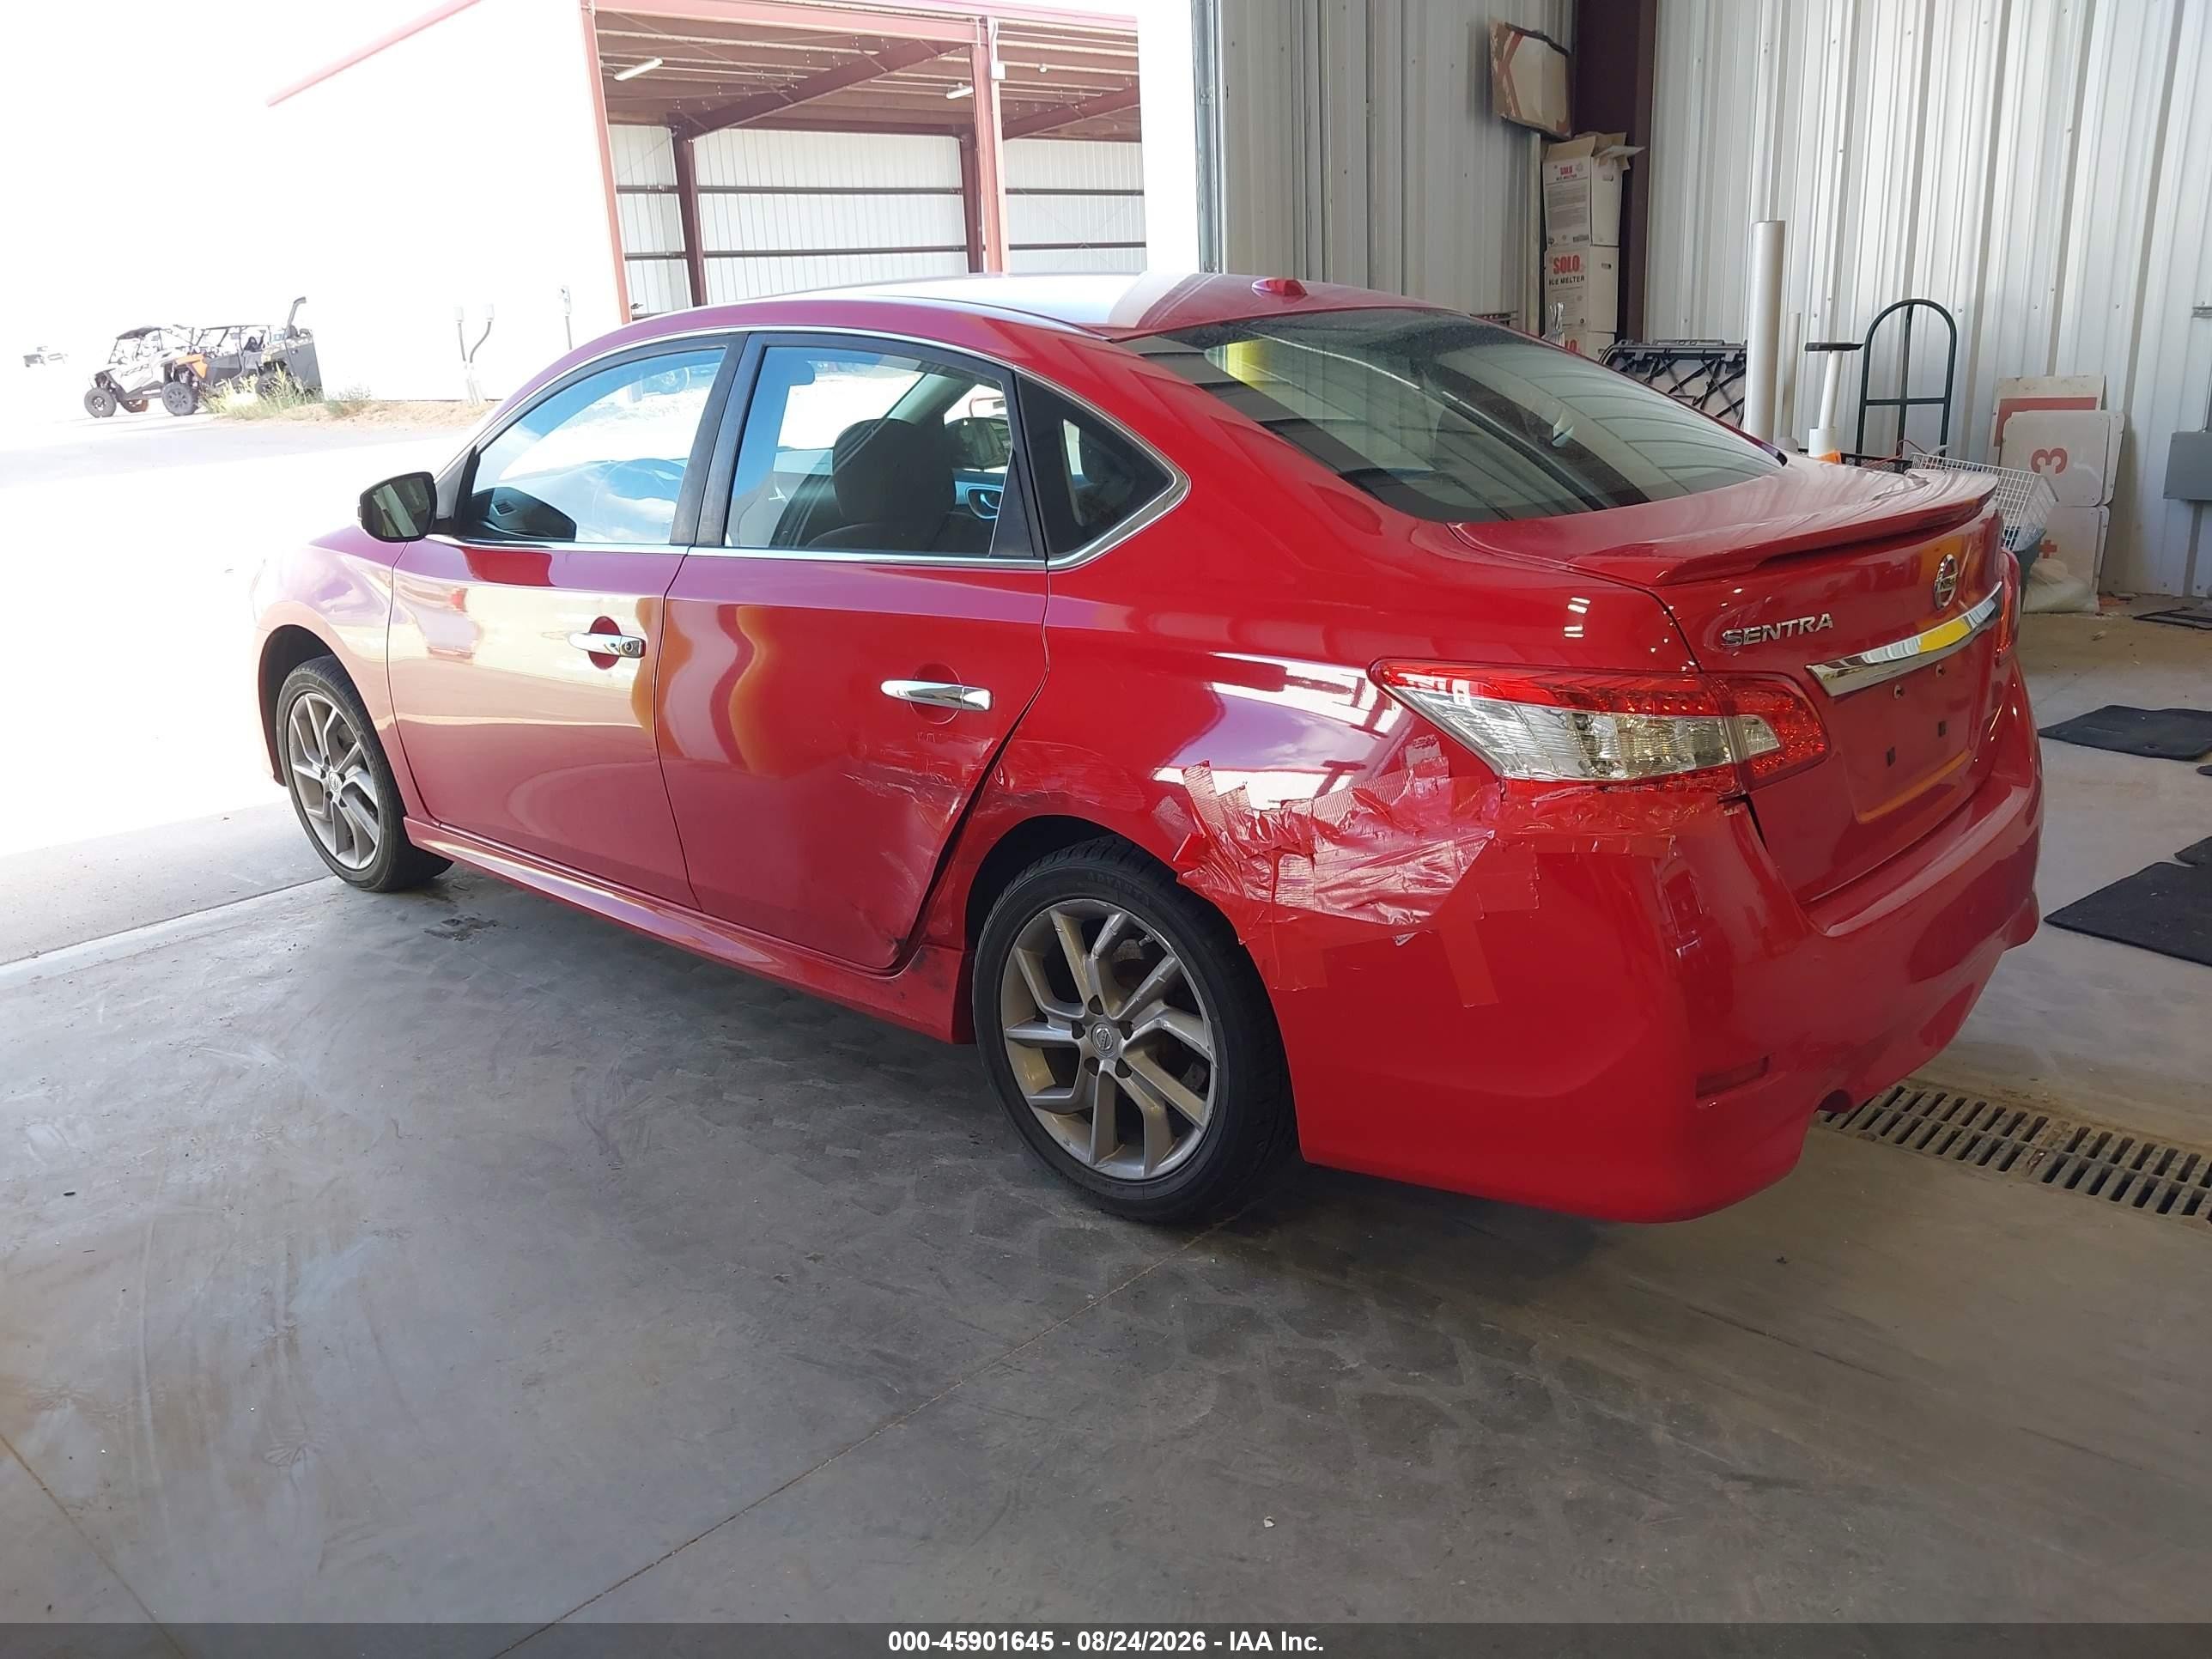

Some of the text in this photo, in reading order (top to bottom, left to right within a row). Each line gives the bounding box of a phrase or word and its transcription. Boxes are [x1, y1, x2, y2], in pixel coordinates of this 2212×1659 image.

[1553, 255, 1581, 275] SOLO
[1549, 275, 1585, 286] ICE MELTER
[2030, 447, 2069, 475] 3
[1721, 612, 1833, 647] SENTRA
